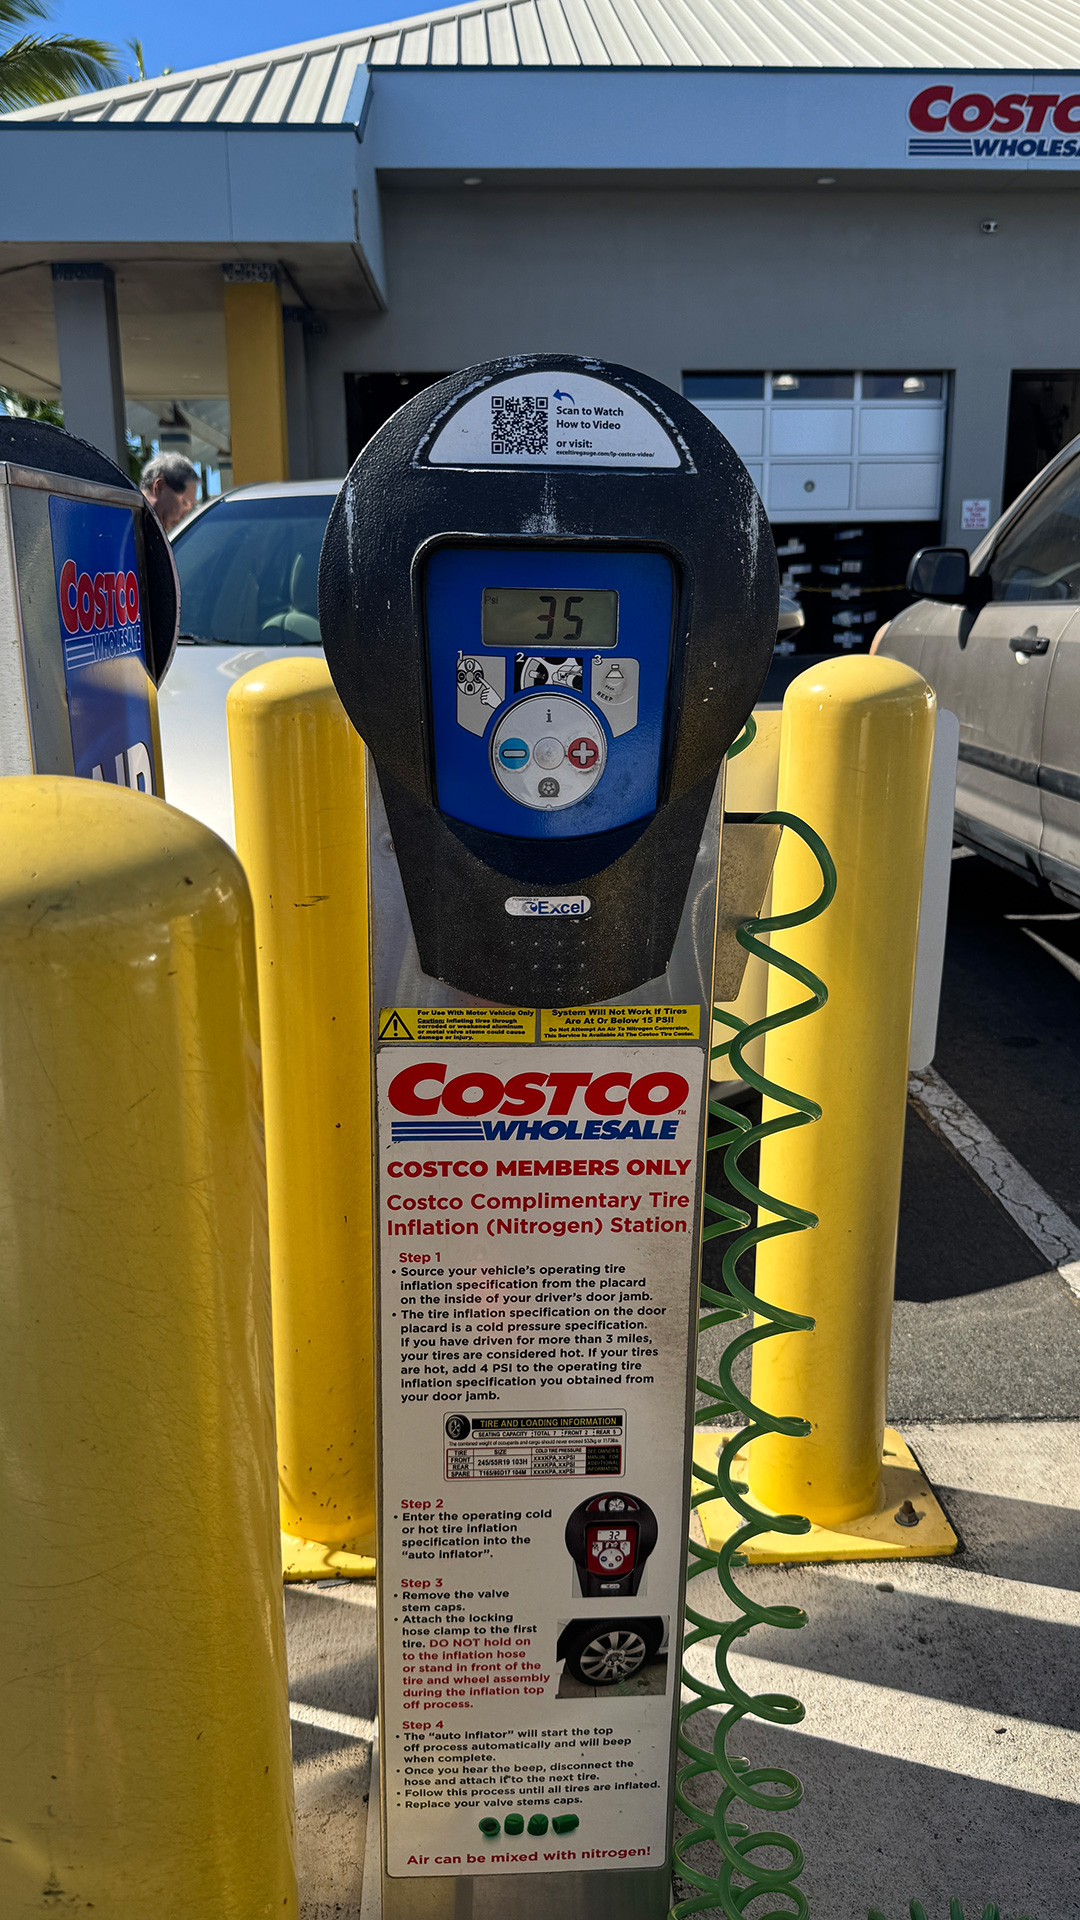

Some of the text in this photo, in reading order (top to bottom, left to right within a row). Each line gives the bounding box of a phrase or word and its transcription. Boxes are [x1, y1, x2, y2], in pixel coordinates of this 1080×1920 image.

[973, 138, 1080, 157] WHOLES
[556, 406, 624, 417] Scan to Watch
[556, 420, 621, 430] How to Video
[556, 439, 593, 449] or visit:
[60, 559, 139, 634] COSTCO
[484, 595, 584, 641] Psi 35
[93, 624, 141, 662] WHOLESALE
[456, 649, 464, 661] 1
[515, 652, 525, 663] 2
[593, 654, 603, 665] 3
[596, 690, 613, 702] BEEP
[545, 709, 553, 723] i
[538, 899, 584, 914] Excel
[552, 1009, 586, 1017] System
[388, 1062, 690, 1117] COSTCO
[482, 1119, 680, 1141] WHOLESALE
[387, 1159, 692, 1179] COSTCO MEMBERS ONLY
[387, 1191, 690, 1213] Costco Complimentary Tire
[387, 1216, 687, 1238] Inflation (Nitrogen) Station
[399, 1252, 441, 1264] Step 1
[400, 1264, 626, 1278] Source your vehicle’s operating tire
[400, 1277, 646, 1291] inflation specification from the placard
[400, 1292, 653, 1305] on the inside of your driver’s door jamb.
[480, 1417, 617, 1428] TIRE AND LOADING INFORMATION
[401, 1499, 444, 1511] Step 2
[402, 1509, 552, 1522] Enter the operating cold
[401, 1523, 518, 1534] or hot tire inflation
[609, 1530, 620, 1540] 32
[401, 1536, 531, 1549] specification into the
[401, 1549, 494, 1560] “auto inflator”.
[401, 1578, 443, 1590] Step 3
[402, 1589, 510, 1600] Remove the valve
[401, 1603, 466, 1614] stem caps.
[402, 1720, 445, 1732] Step 4
[404, 1727, 614, 1741] The “auto inflator” will start the top
[403, 1753, 496, 1764] when complete.
[406, 1846, 651, 1865] Air can be mixed with nitrogen!
